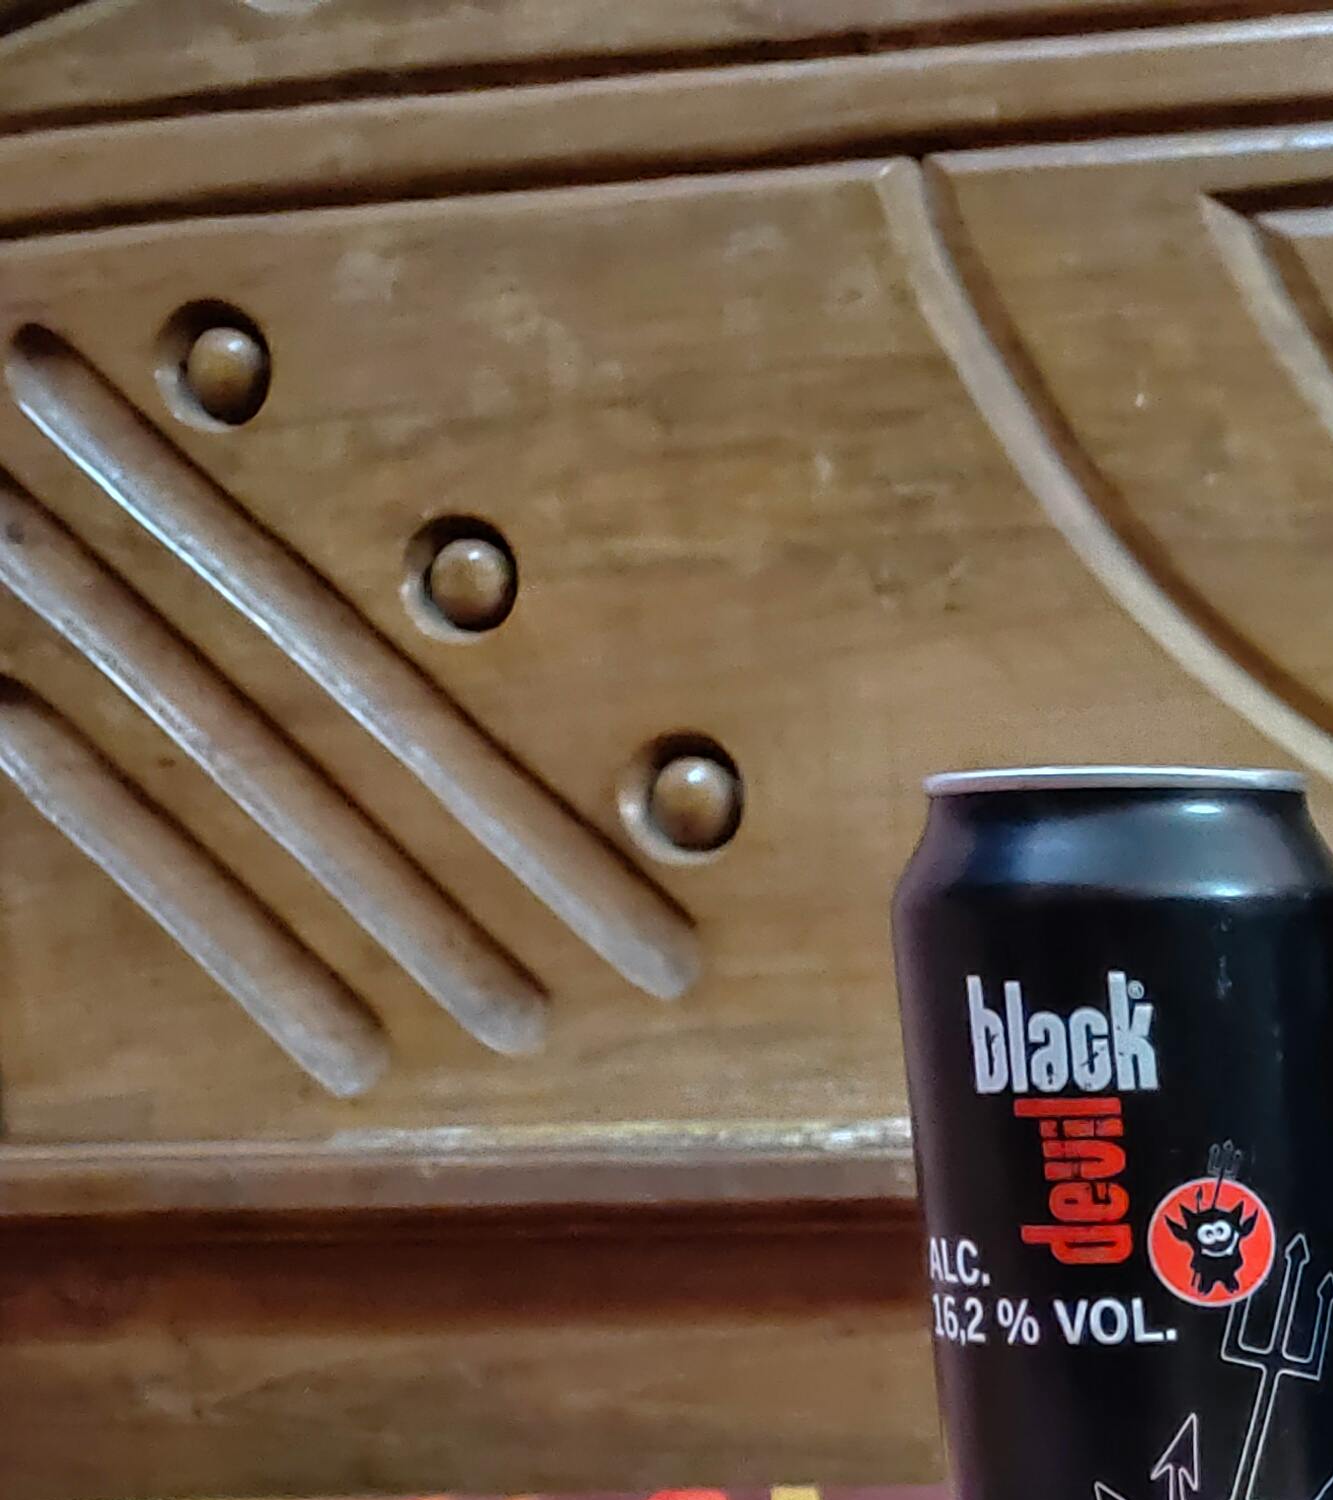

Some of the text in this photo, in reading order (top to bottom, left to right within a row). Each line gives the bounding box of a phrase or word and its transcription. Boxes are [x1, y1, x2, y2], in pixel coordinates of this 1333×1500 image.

[1014, 1097, 1132, 1264] devil
[929, 1236, 990, 1286] ALC.
[933, 1293, 1178, 1346] 16,2 % VOL.
